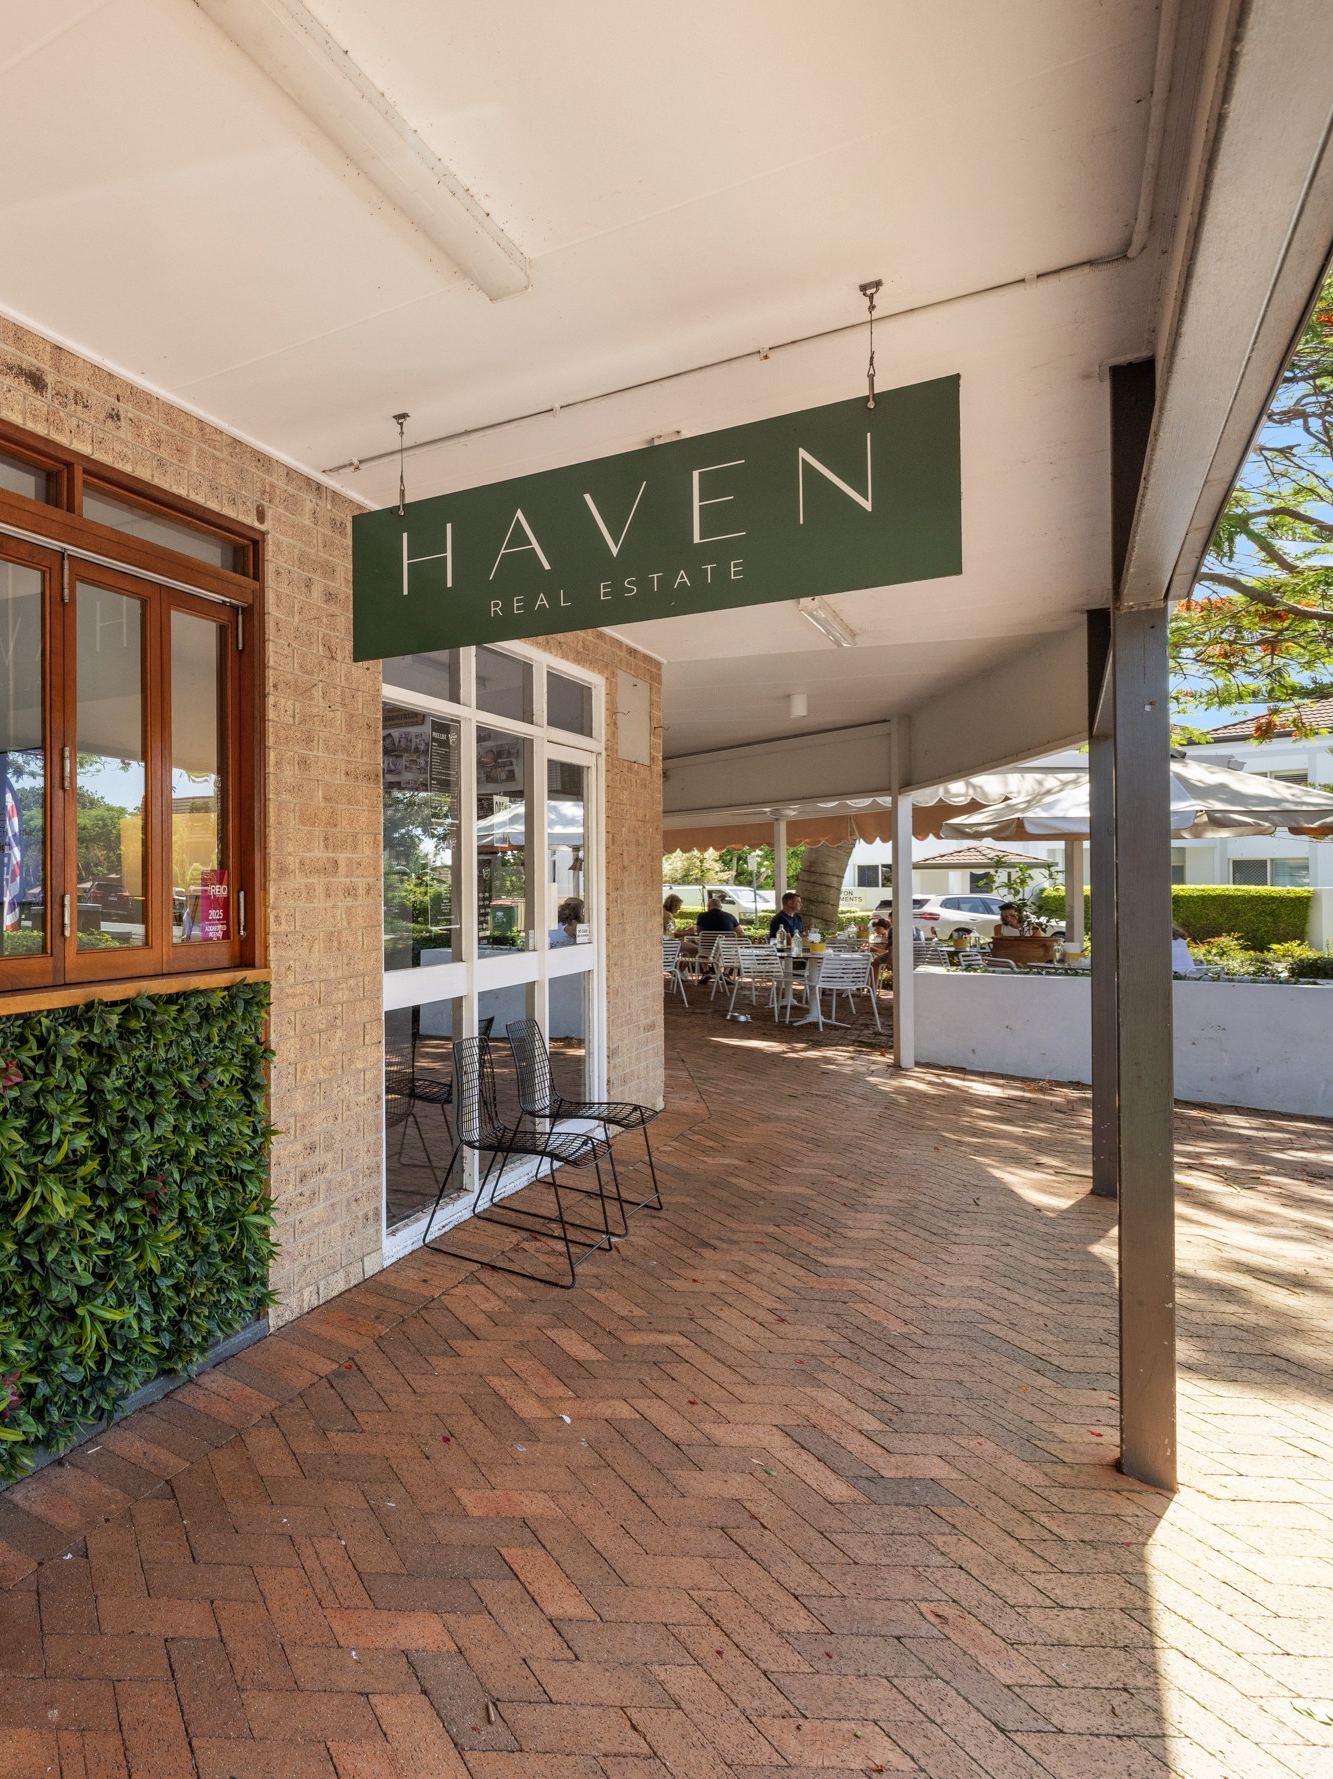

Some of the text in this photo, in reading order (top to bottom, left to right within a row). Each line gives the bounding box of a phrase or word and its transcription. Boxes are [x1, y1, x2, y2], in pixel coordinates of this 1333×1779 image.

[402, 432, 872, 596] HAVEN
[490, 560, 744, 617] REAL ESTATE
[210, 884, 228, 895] REIQ
[208, 909, 224, 920] 2025
